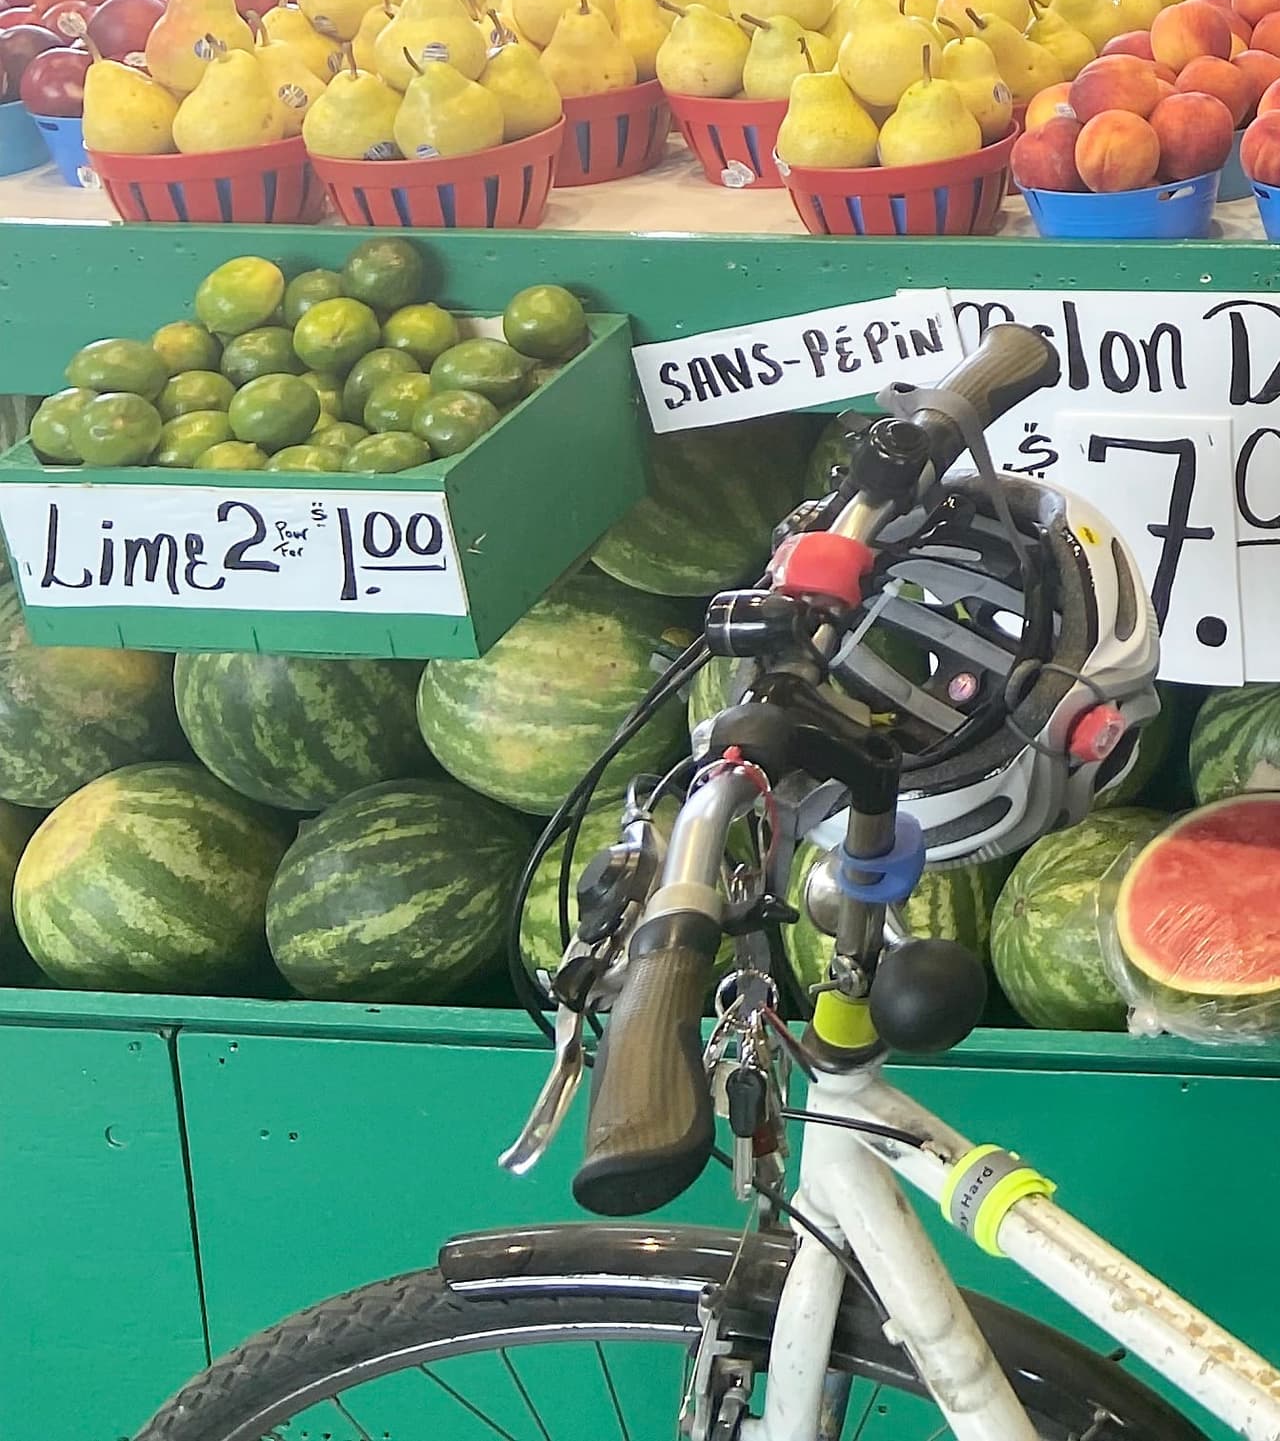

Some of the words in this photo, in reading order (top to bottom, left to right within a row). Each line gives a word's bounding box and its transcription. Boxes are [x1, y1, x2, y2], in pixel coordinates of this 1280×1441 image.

[41, 502, 226, 596] Lime
[217, 500, 280, 573] 2
[961, 1166, 994, 1208] Hard
